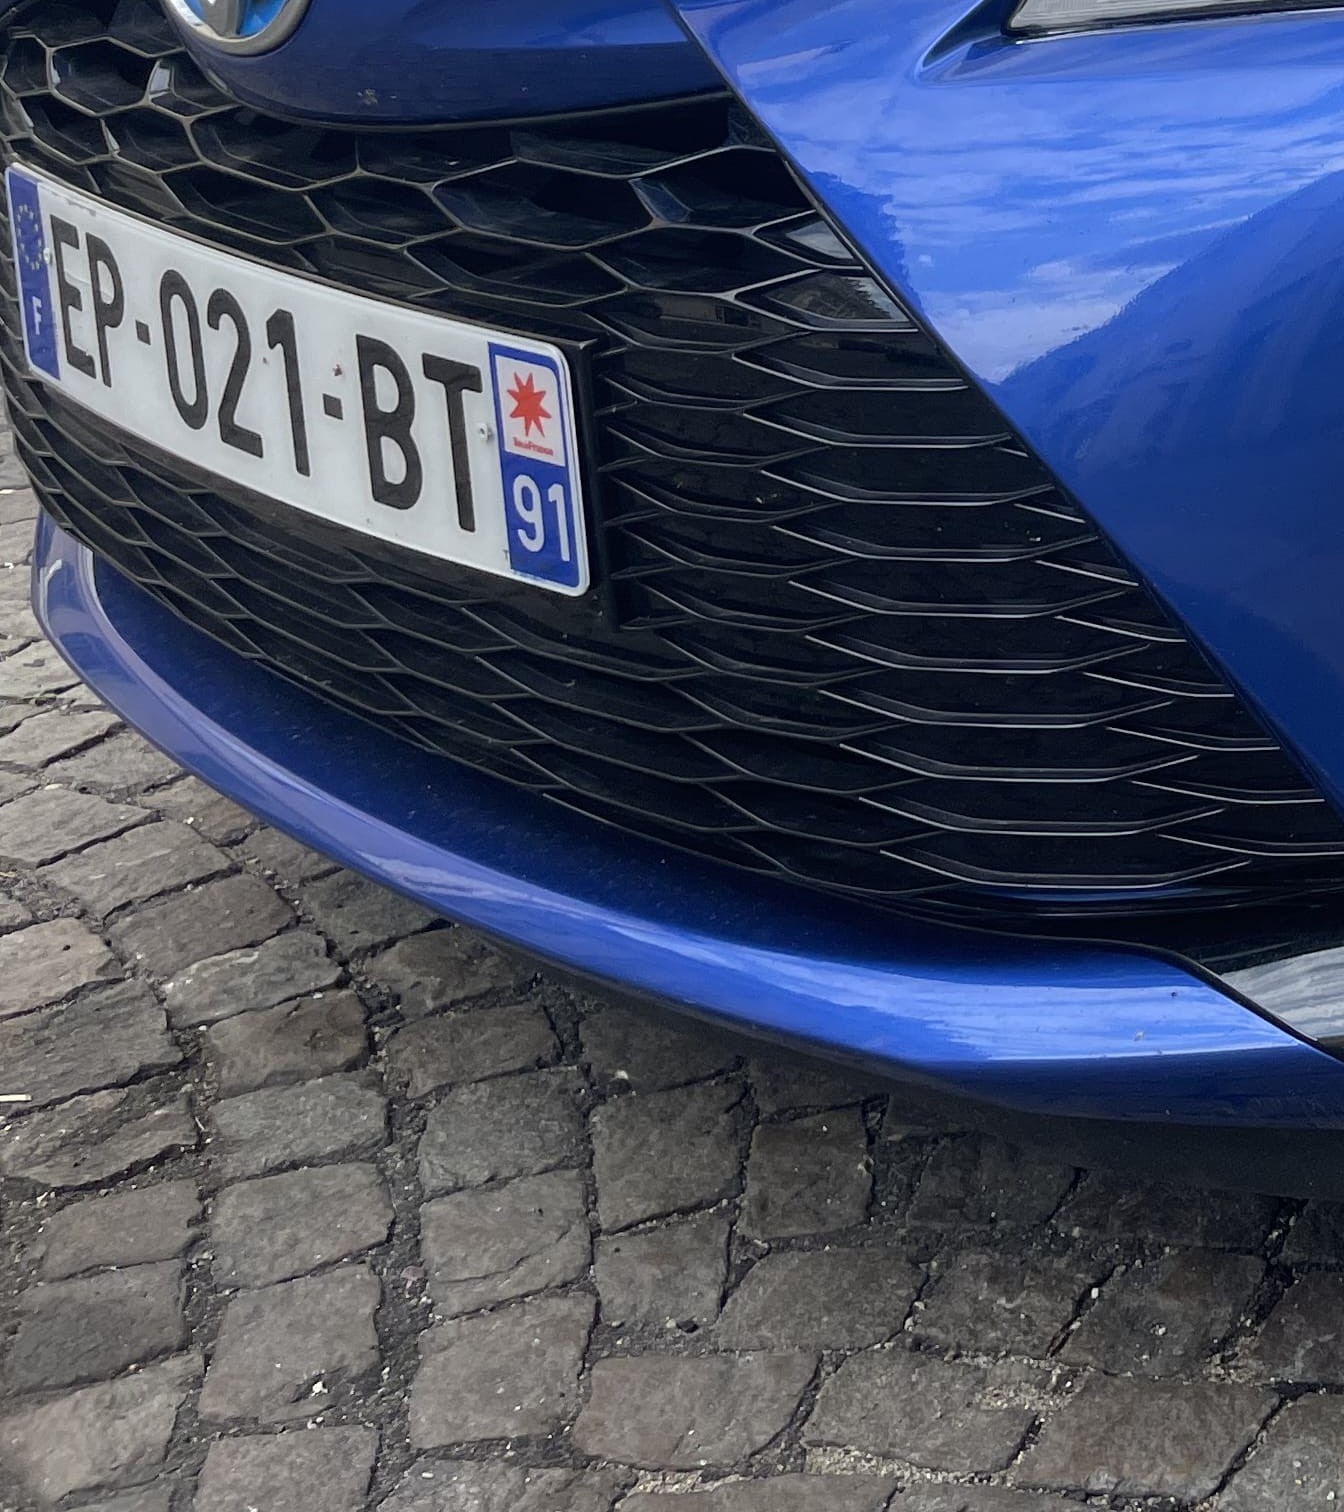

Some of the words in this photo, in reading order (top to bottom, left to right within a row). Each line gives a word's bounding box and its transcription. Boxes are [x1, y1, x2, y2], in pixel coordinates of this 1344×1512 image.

[31, 296, 44, 336] F
[51, 214, 483, 533] EP-021-BT
[513, 474, 571, 562] 91
